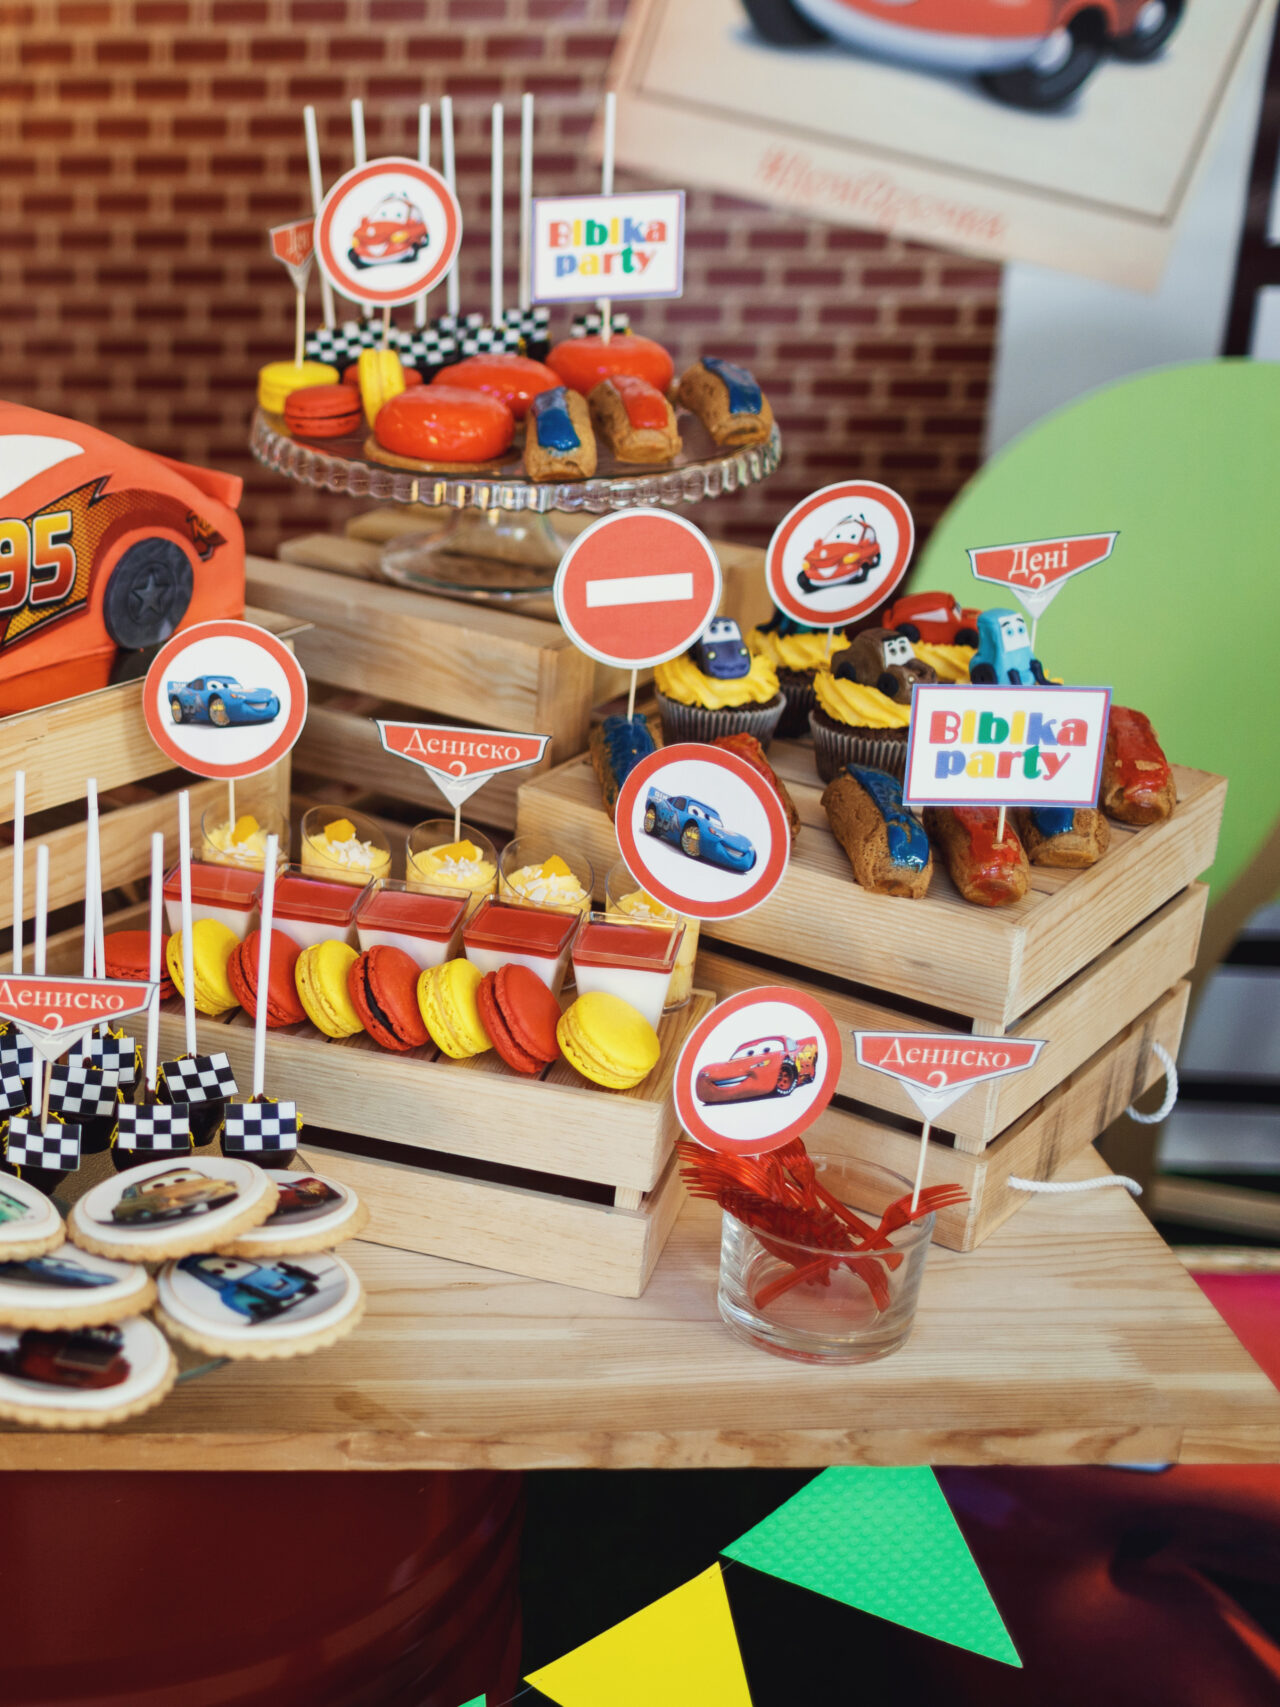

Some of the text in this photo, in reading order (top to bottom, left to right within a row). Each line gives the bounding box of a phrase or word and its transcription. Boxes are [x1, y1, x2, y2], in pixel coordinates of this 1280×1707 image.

[556, 245, 656, 277] party
[404, 729, 520, 761] Дениско
[447, 761, 467, 790] 2
[935, 745, 1070, 780] party
[42, 1013, 64, 1044] 2
[879, 1038, 1010, 1068] Дениско
